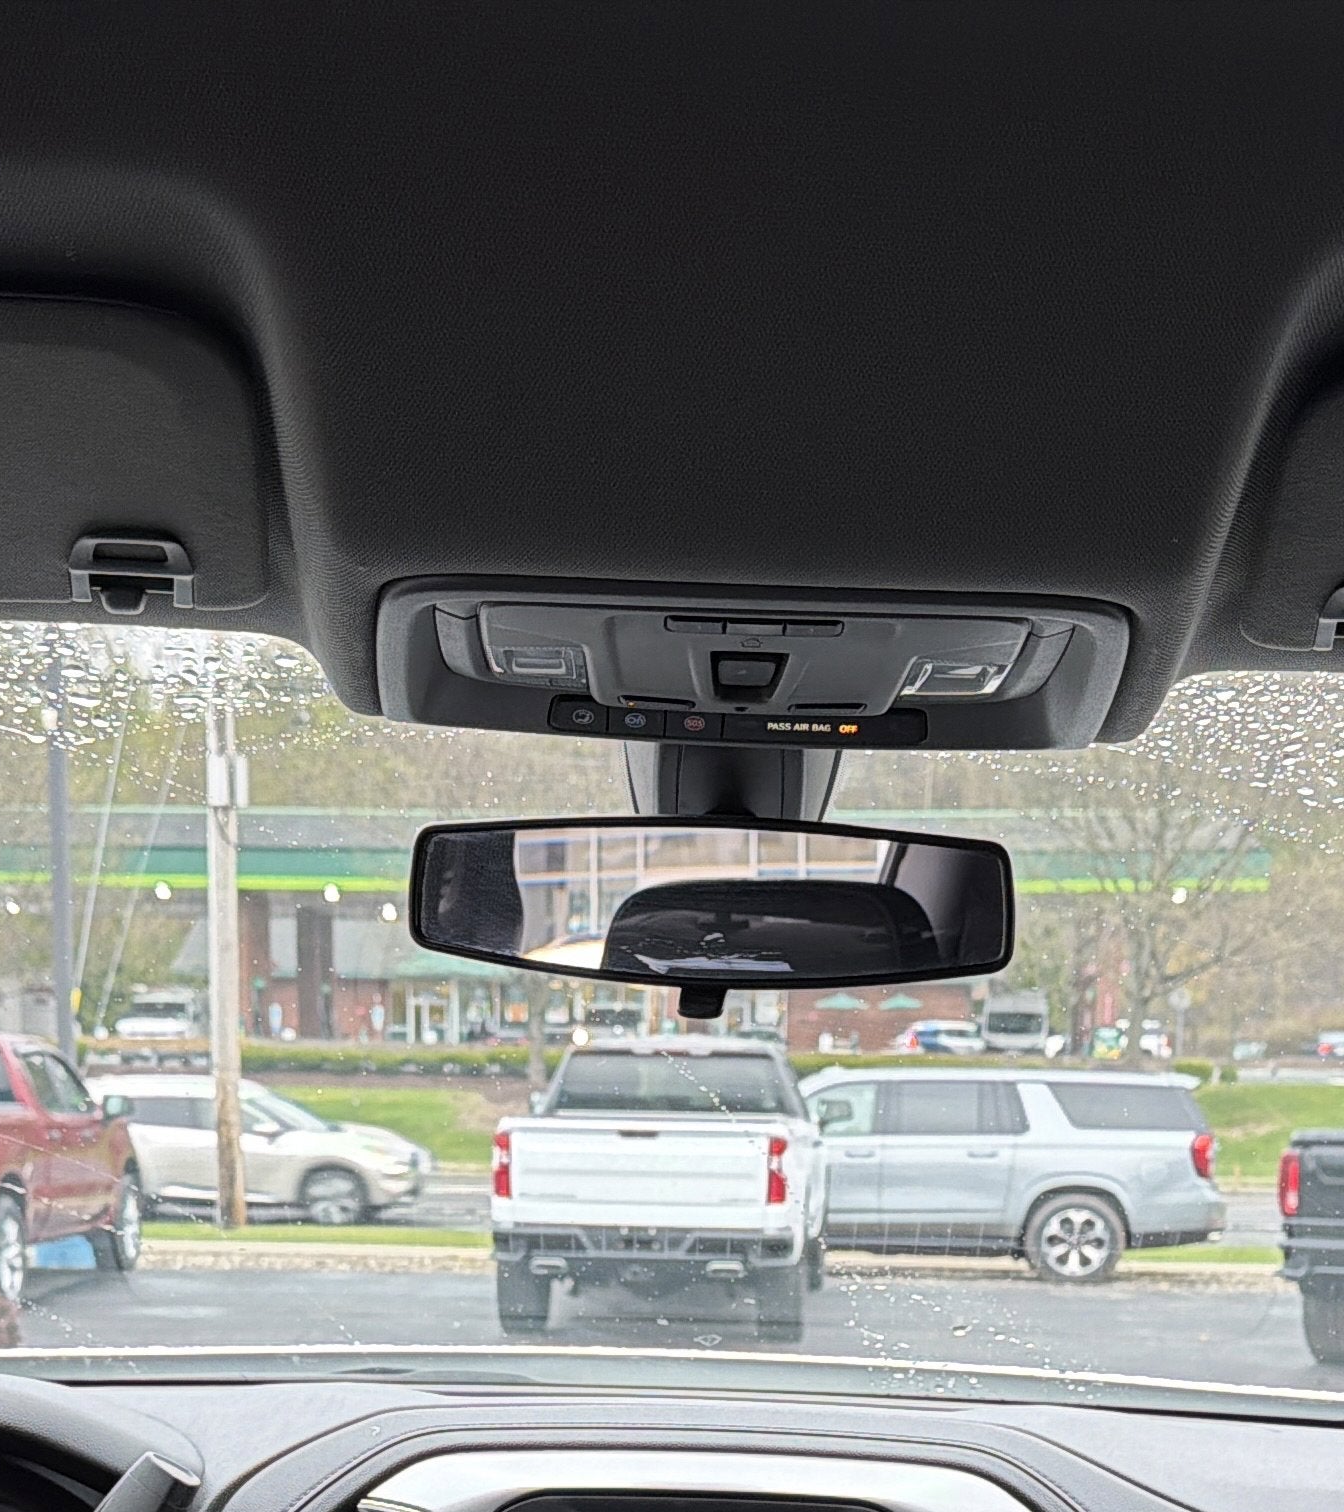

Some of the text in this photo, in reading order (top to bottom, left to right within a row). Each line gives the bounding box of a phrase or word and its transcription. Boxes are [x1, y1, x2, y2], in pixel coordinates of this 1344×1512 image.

[767, 722, 858, 734] PASS AIR BAG OFF
